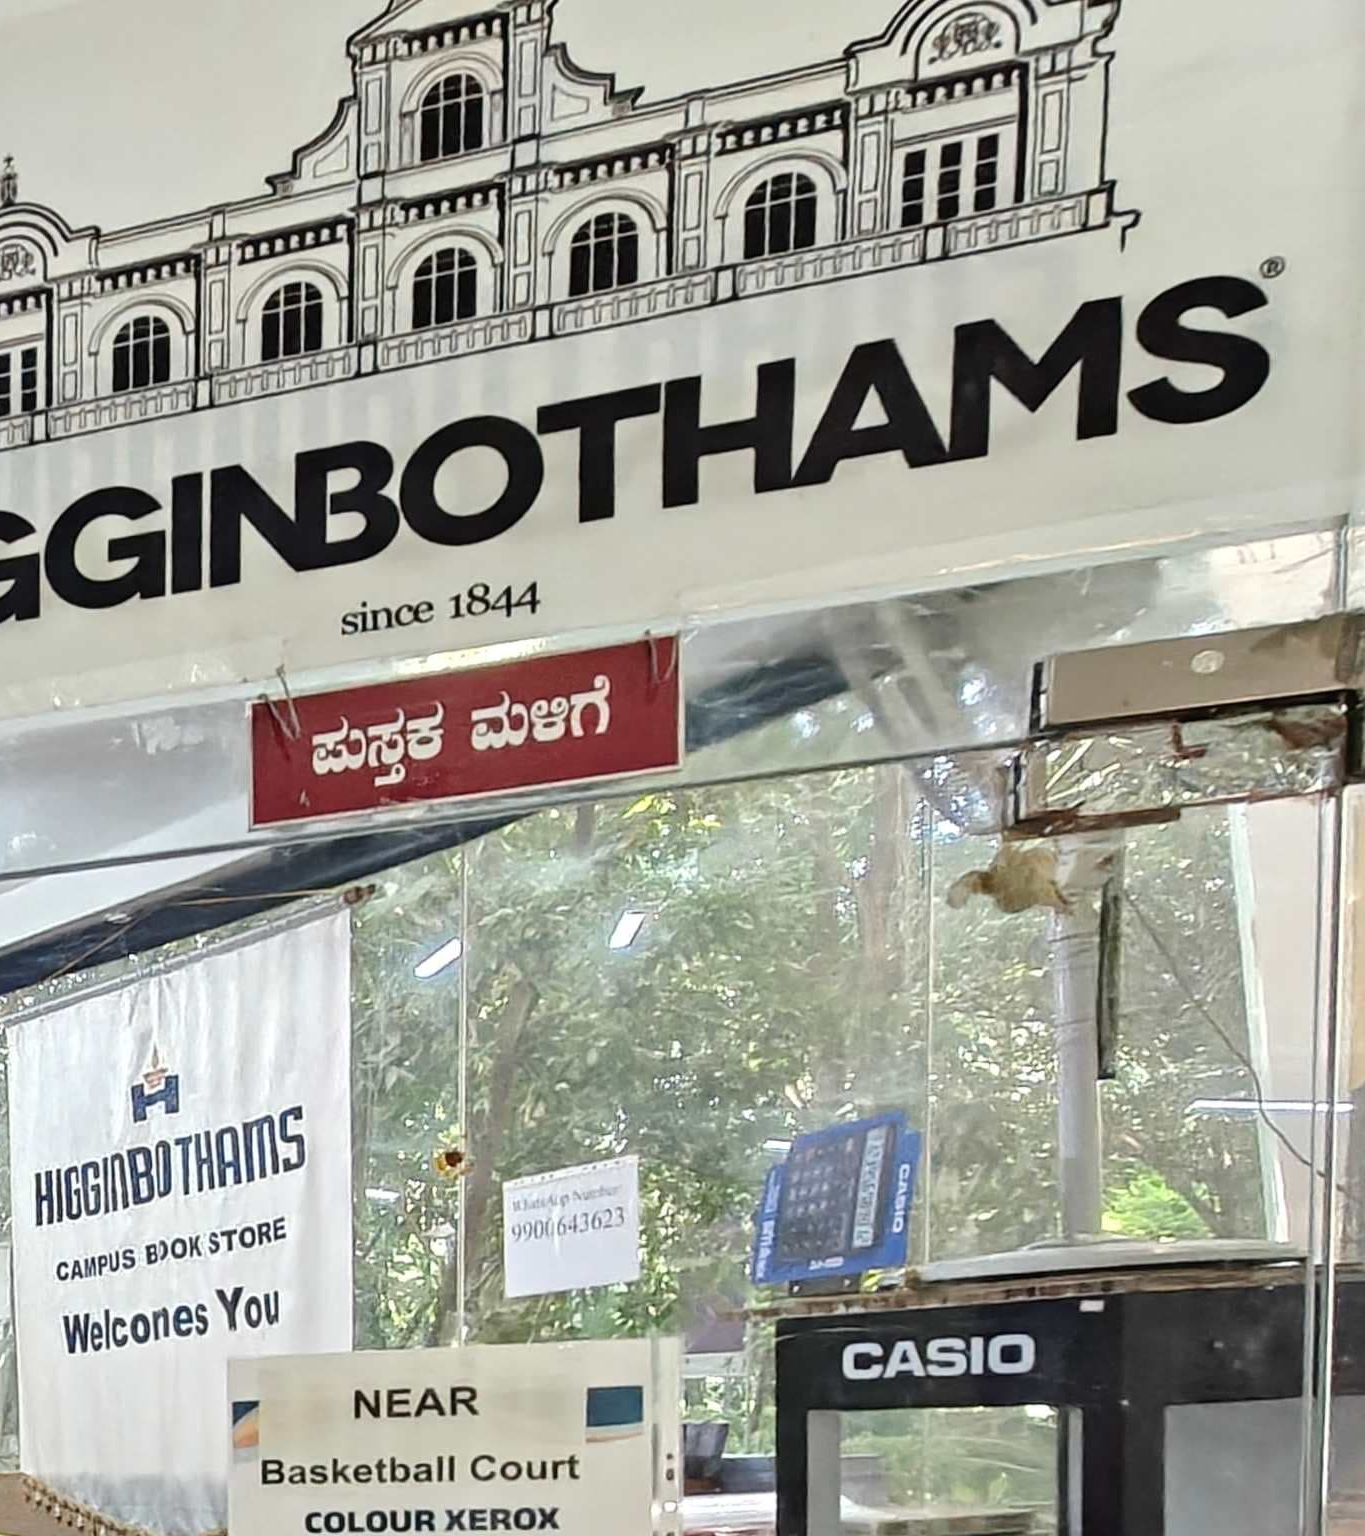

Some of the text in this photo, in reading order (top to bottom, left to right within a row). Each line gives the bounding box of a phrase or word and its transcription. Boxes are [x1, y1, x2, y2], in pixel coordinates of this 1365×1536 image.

[341, 581, 541, 635] since 1844
[312, 674, 611, 787] ಪುಸ್ತಕ ಮಳಿಗೆ
[35, 1106, 306, 1226] HIGGINBOTHAMS
[892, 1163, 910, 1233] CASIO
[56, 1249, 135, 1281] CAMPUS
[208, 1217, 287, 1254] STORE
[215, 1286, 280, 1331] You
[842, 1334, 1035, 1381] CASIO
[354, 1386, 479, 1419] NEAR
[261, 1454, 580, 1485] Basketball Court
[305, 1507, 560, 1533] COLOUR XEROX
